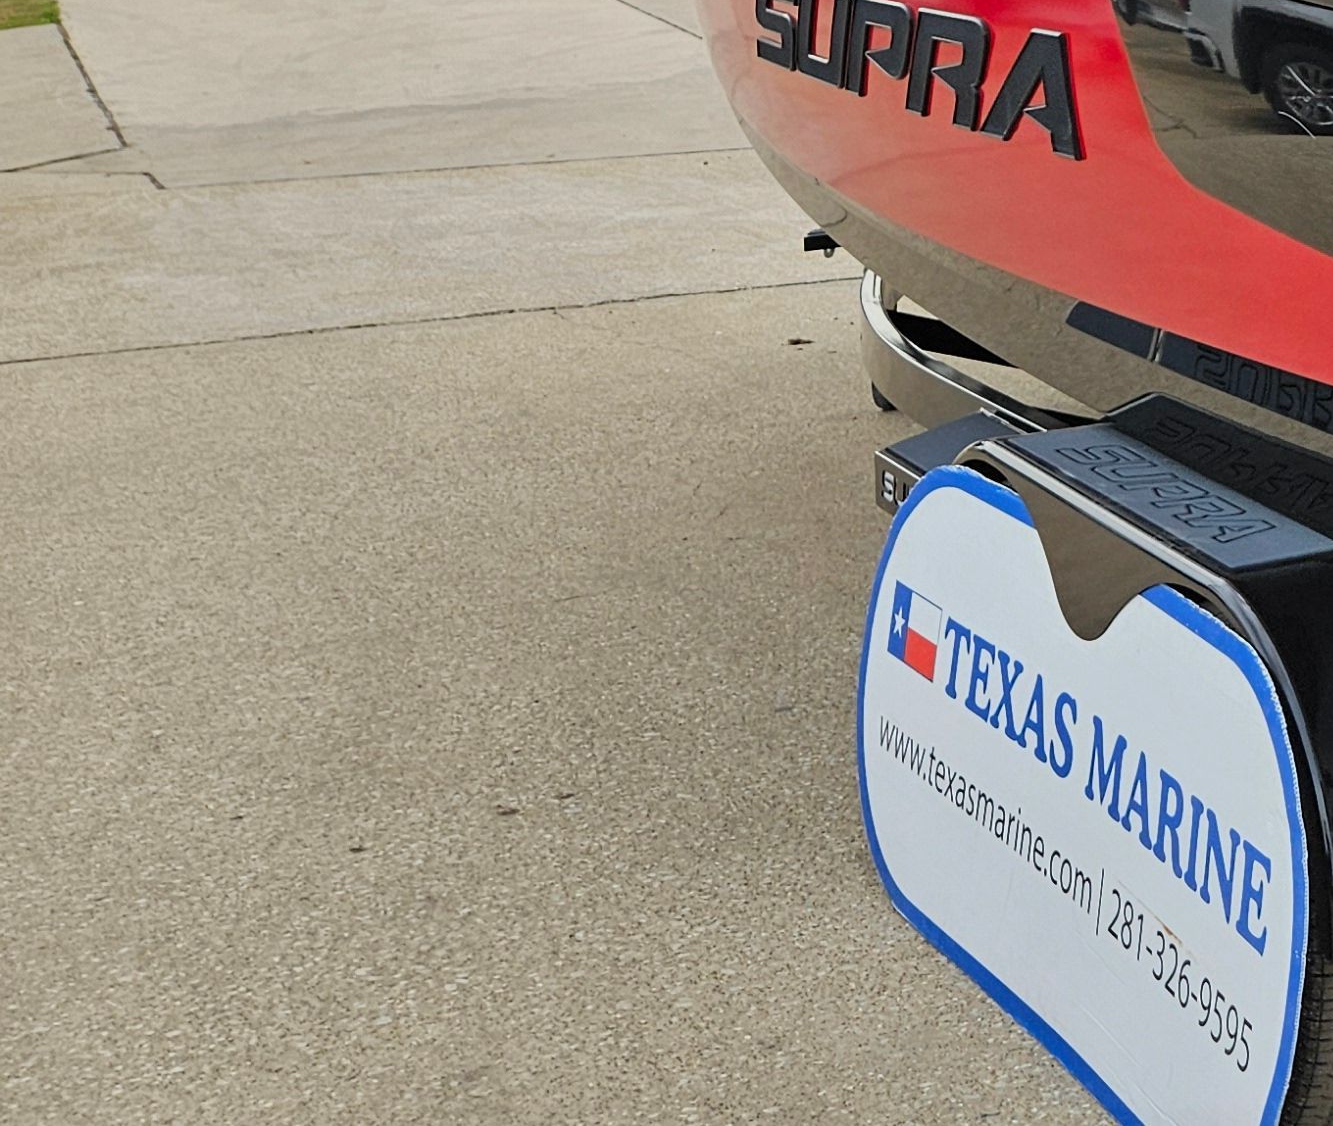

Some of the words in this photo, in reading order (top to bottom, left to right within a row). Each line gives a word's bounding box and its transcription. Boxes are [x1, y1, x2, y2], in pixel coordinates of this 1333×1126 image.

[1055, 444, 1277, 544] SUPRA
[879, 715, 1093, 915] www.texasmarine.com
[1107, 887, 1254, 1073] 281-326-9595
[944, 615, 1078, 779] TEXAS
[1083, 714, 1272, 957] MARINE
